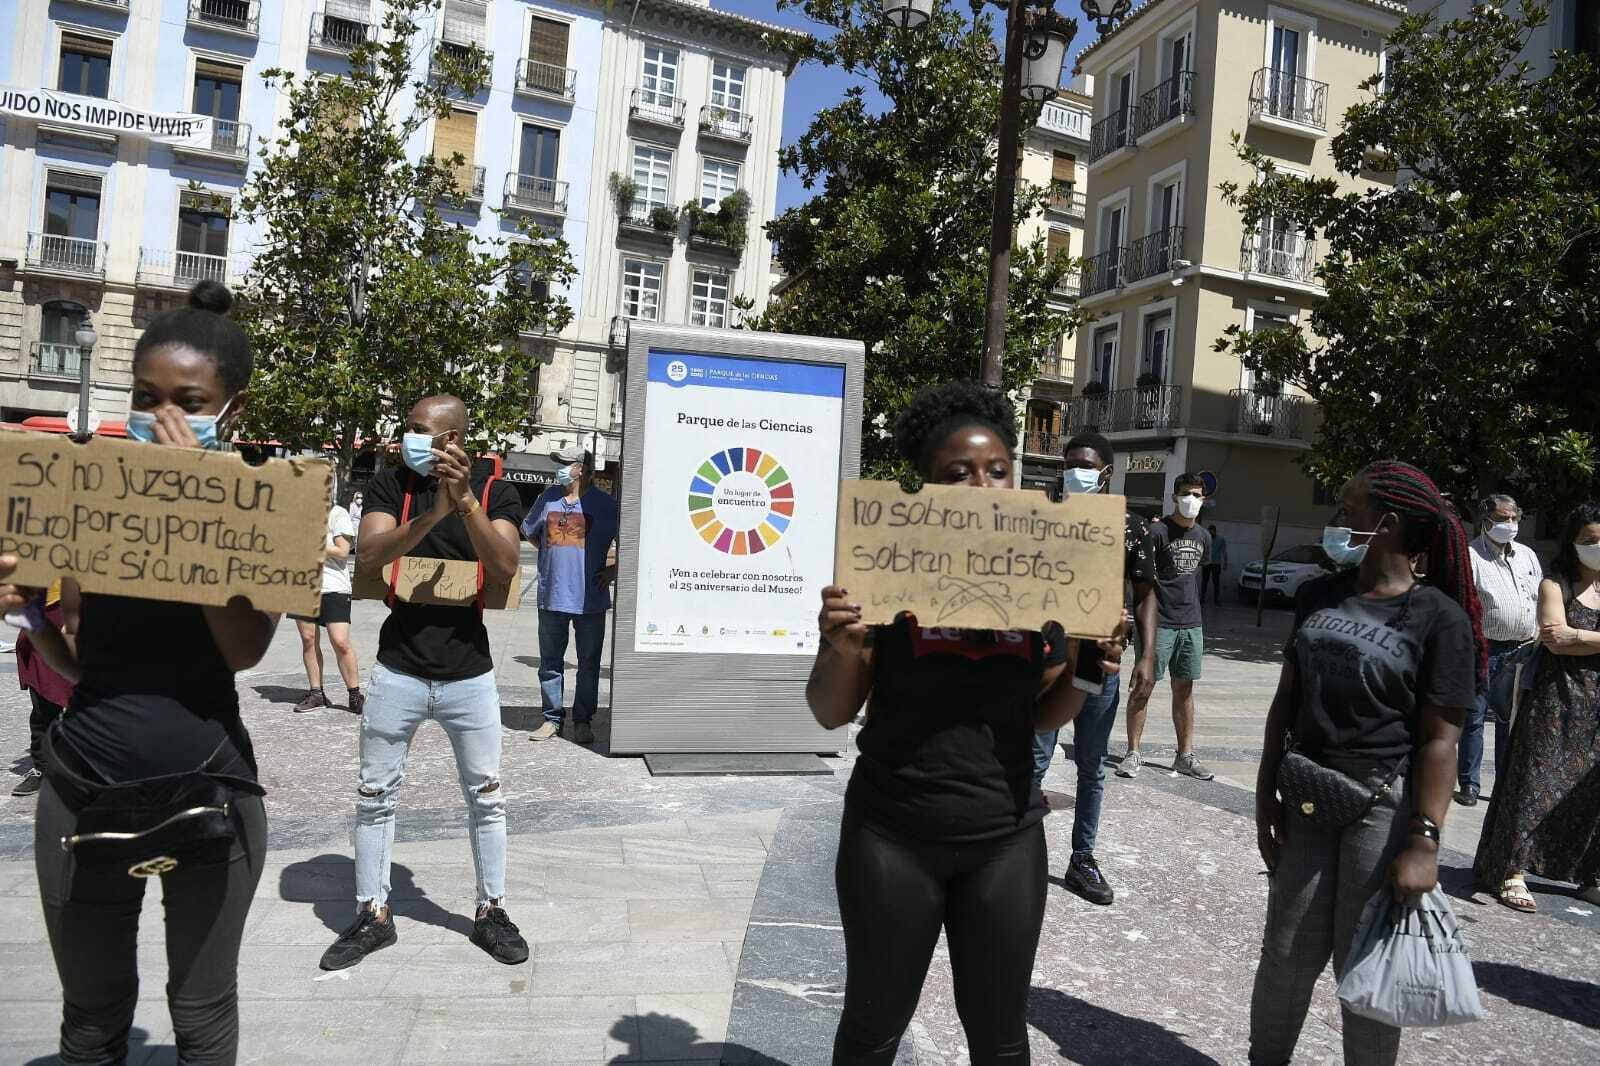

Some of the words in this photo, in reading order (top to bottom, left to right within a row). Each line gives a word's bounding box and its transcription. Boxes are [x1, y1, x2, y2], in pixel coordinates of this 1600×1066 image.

[45, 98, 81, 121] NOS
[86, 106, 145, 130] IMPIDE
[149, 115, 191, 137] VIVIR
[671, 364, 683, 373] 25
[677, 412, 724, 428] Parque
[726, 419, 740, 428] de
[742, 419, 757, 429] las
[759, 419, 813, 434] Ciencias
[72, 459, 104, 491] no
[114, 456, 226, 504] juzgas
[513, 472, 544, 483] CUEVA
[724, 488, 734, 496] Un
[734, 489, 752, 497] lugar
[718, 497, 766, 507] encuentro
[853, 497, 882, 526] no
[888, 497, 982, 530] sobran
[992, 503, 1116, 546] inmigrantes
[852, 543, 952, 575] sobran
[967, 547, 1075, 586] racistas
[180, 563, 219, 585] una
[669, 568, 690, 579] ¡Ven
[700, 570, 740, 580] celebrar
[762, 573, 804, 582] nosotros
[670, 581, 678, 590] el
[680, 583, 692, 591] 25
[694, 582, 750, 592] aniversario
[752, 584, 766, 592] del
[768, 584, 802, 594] Museo!
